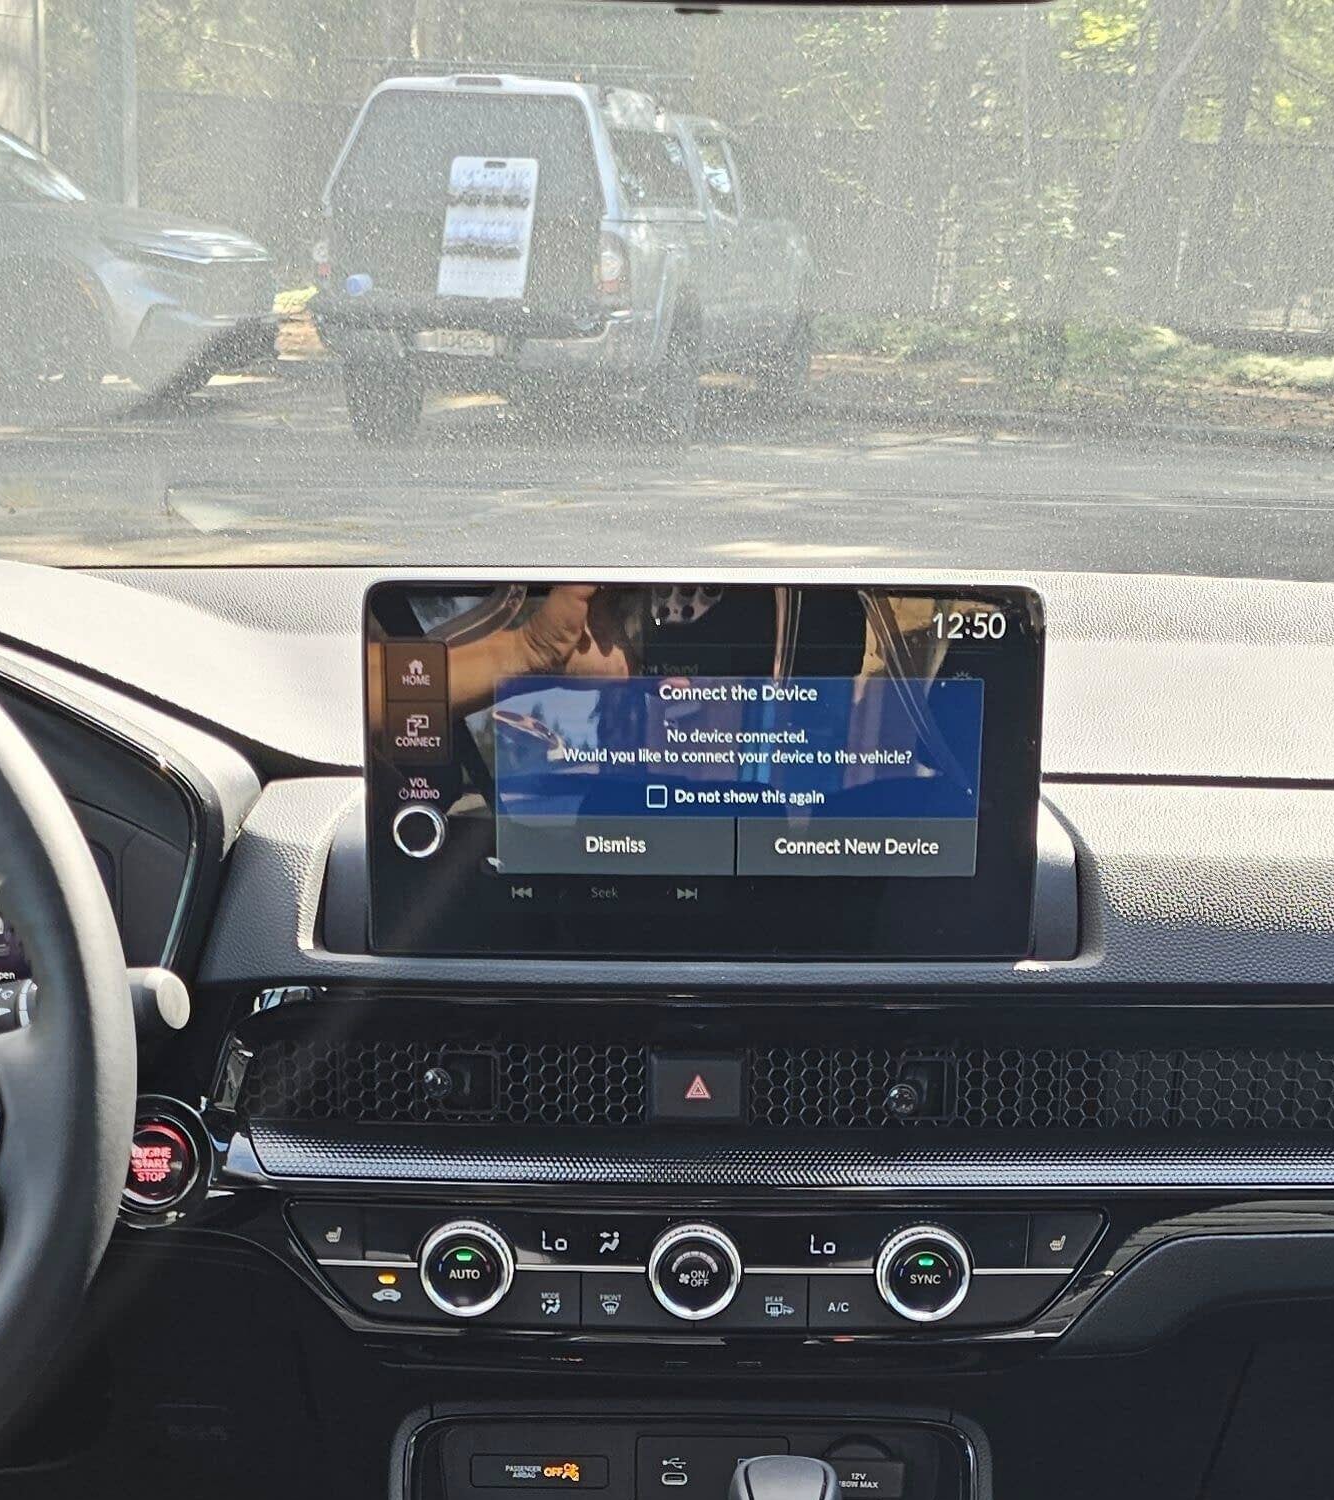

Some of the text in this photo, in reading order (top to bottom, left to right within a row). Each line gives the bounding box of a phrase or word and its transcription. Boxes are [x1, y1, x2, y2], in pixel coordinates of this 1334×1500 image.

[932, 612, 1006, 640] 12:50
[401, 675, 431, 687] HOME
[658, 684, 818, 702] Connect the Device
[395, 736, 441, 748] CONNECT
[667, 728, 808, 745] No device connected.
[563, 749, 913, 766] Would you like to connect your device to the vehicle?
[409, 777, 429, 789] VOL
[410, 788, 441, 800] AUDIO
[674, 789, 825, 806] Do not show this again
[585, 835, 647, 854] Dismiss
[774, 837, 940, 855] Connect New Device
[137, 1172, 166, 1182] STOP
[541, 1230, 568, 1251] Lo
[809, 1233, 836, 1254] Lo
[448, 1268, 481, 1280] AUTO
[689, 1269, 710, 1279] ON/
[909, 1273, 942, 1285] SYNC
[689, 1278, 710, 1288] OFF
[540, 1292, 560, 1300] MODE
[599, 1293, 622, 1301] FRONT
[827, 1302, 850, 1313] A/C
[504, 1464, 542, 1473] PASSENGER
[543, 1466, 564, 1478] OFF
[850, 1472, 867, 1481] 12V
[859, 1480, 879, 1489] MAX
